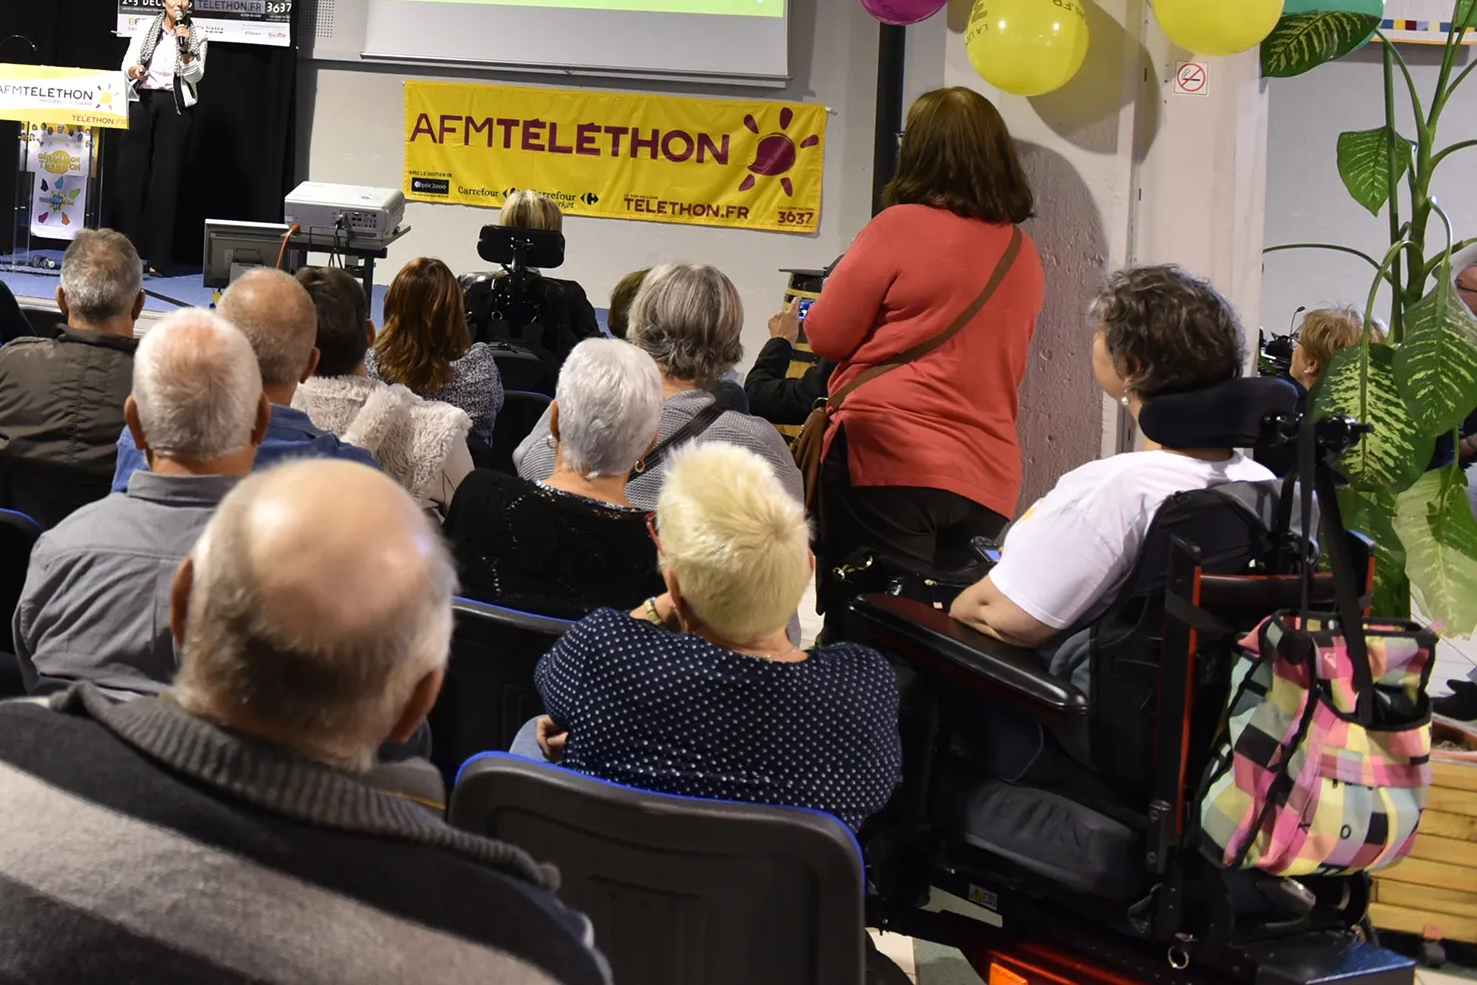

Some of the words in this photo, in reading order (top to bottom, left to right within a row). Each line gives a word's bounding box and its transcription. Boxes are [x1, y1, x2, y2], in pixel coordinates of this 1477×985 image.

[197, 0, 262, 12] TELETHON.FR
[267, 2, 292, 13] 3637
[457, 185, 499, 197] Carrefour
[624, 197, 750, 220] TELETHON.FR
[778, 210, 814, 225] 3637
